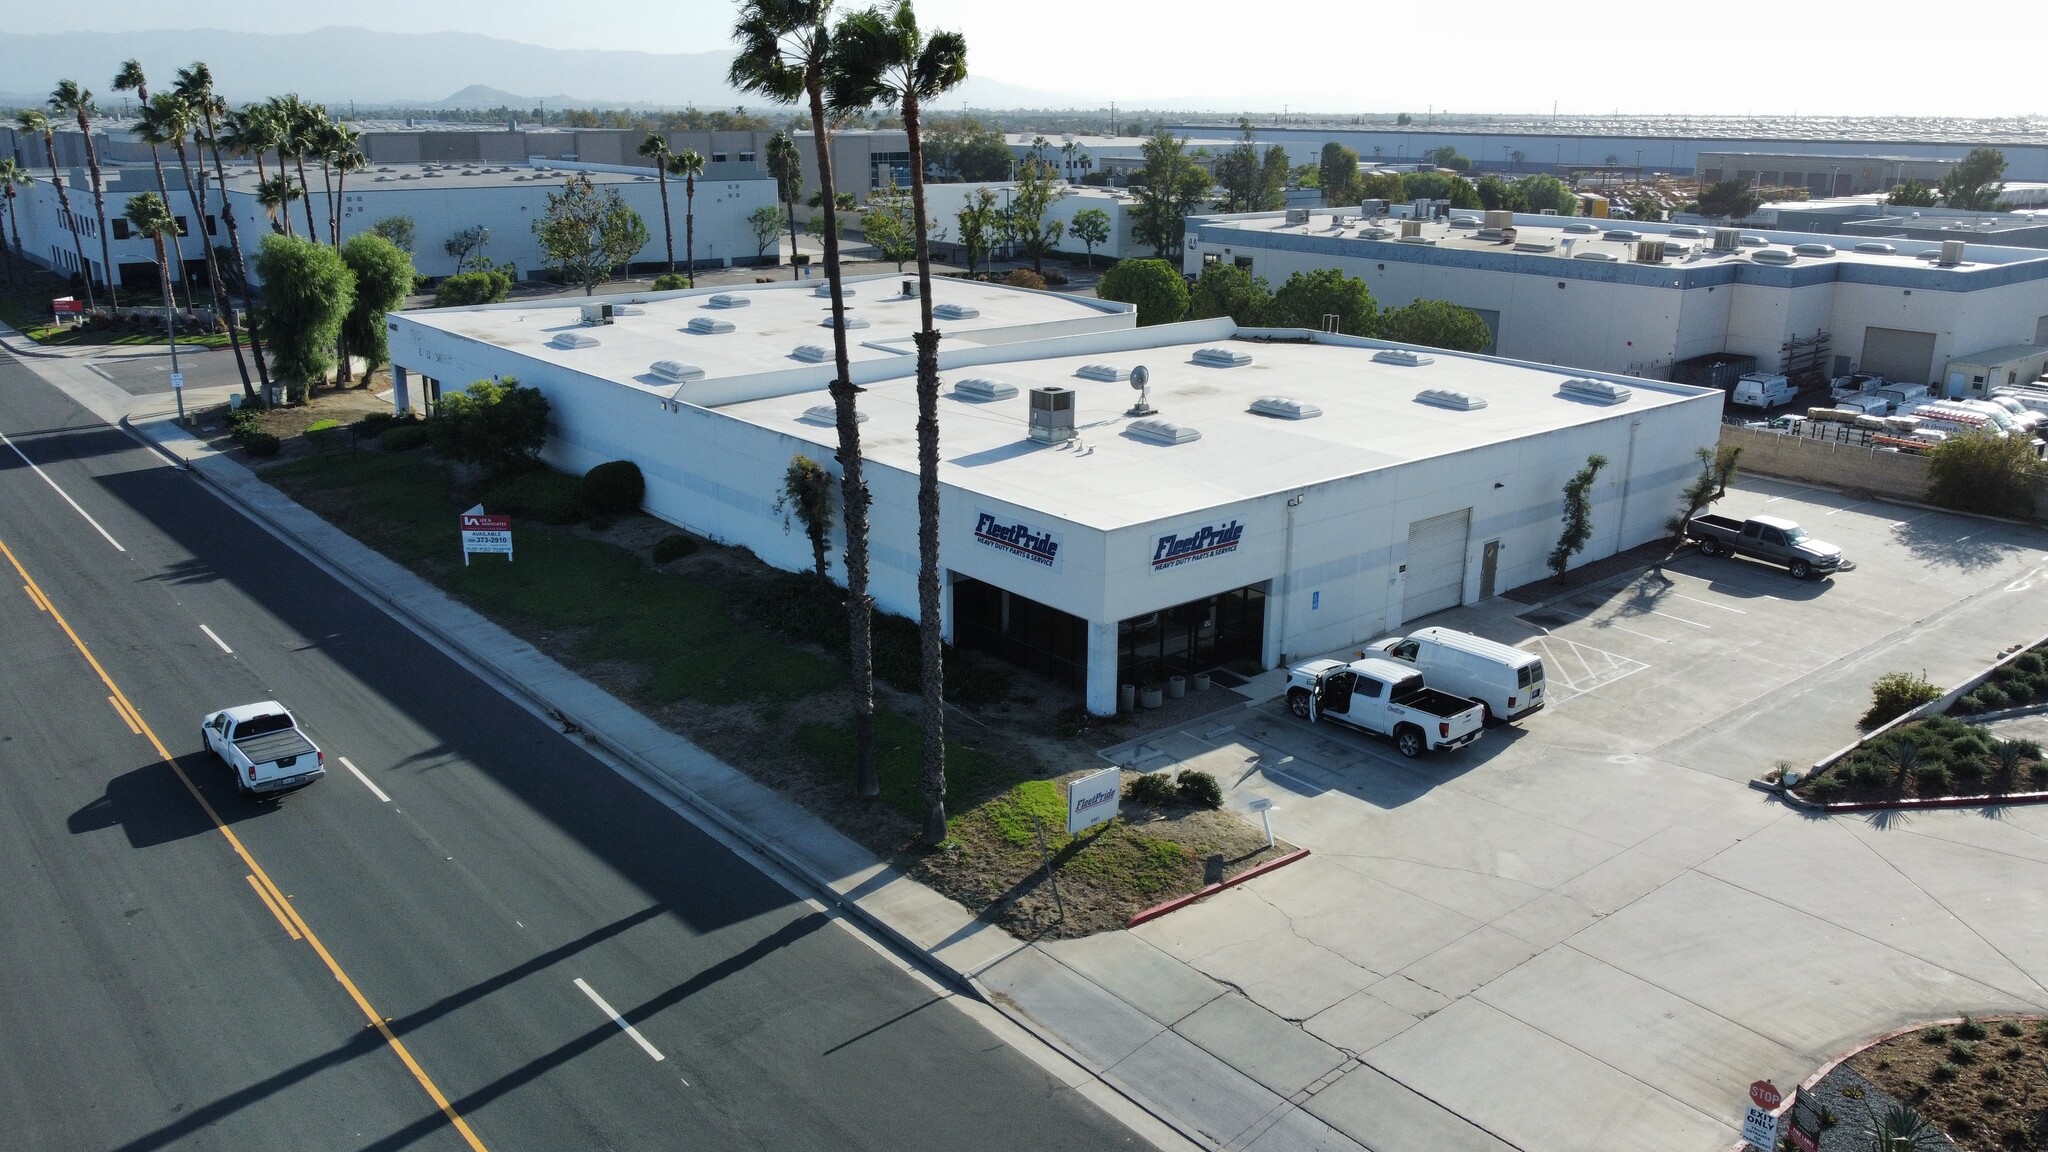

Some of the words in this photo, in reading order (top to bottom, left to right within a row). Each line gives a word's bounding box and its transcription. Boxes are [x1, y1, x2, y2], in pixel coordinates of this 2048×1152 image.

[975, 512, 1058, 556] FleetPride
[1154, 520, 1243, 560] FleetPride
[977, 537, 995, 547] HEAVY
[995, 542, 1009, 552] DUTY
[1009, 547, 1026, 559] PARTS
[1031, 554, 1054, 568] SERVICE
[1155, 561, 1176, 571] HEAVY
[1175, 557, 1191, 566] DUTY
[1192, 551, 1209, 562] PARTS
[1215, 544, 1238, 555] SERVICE
[1075, 788, 1116, 810] FleetPride
[1751, 1086, 1780, 1104] STOP
[1747, 1115, 1774, 1131] ONLY
[1750, 1108, 1774, 1123] EXIT
